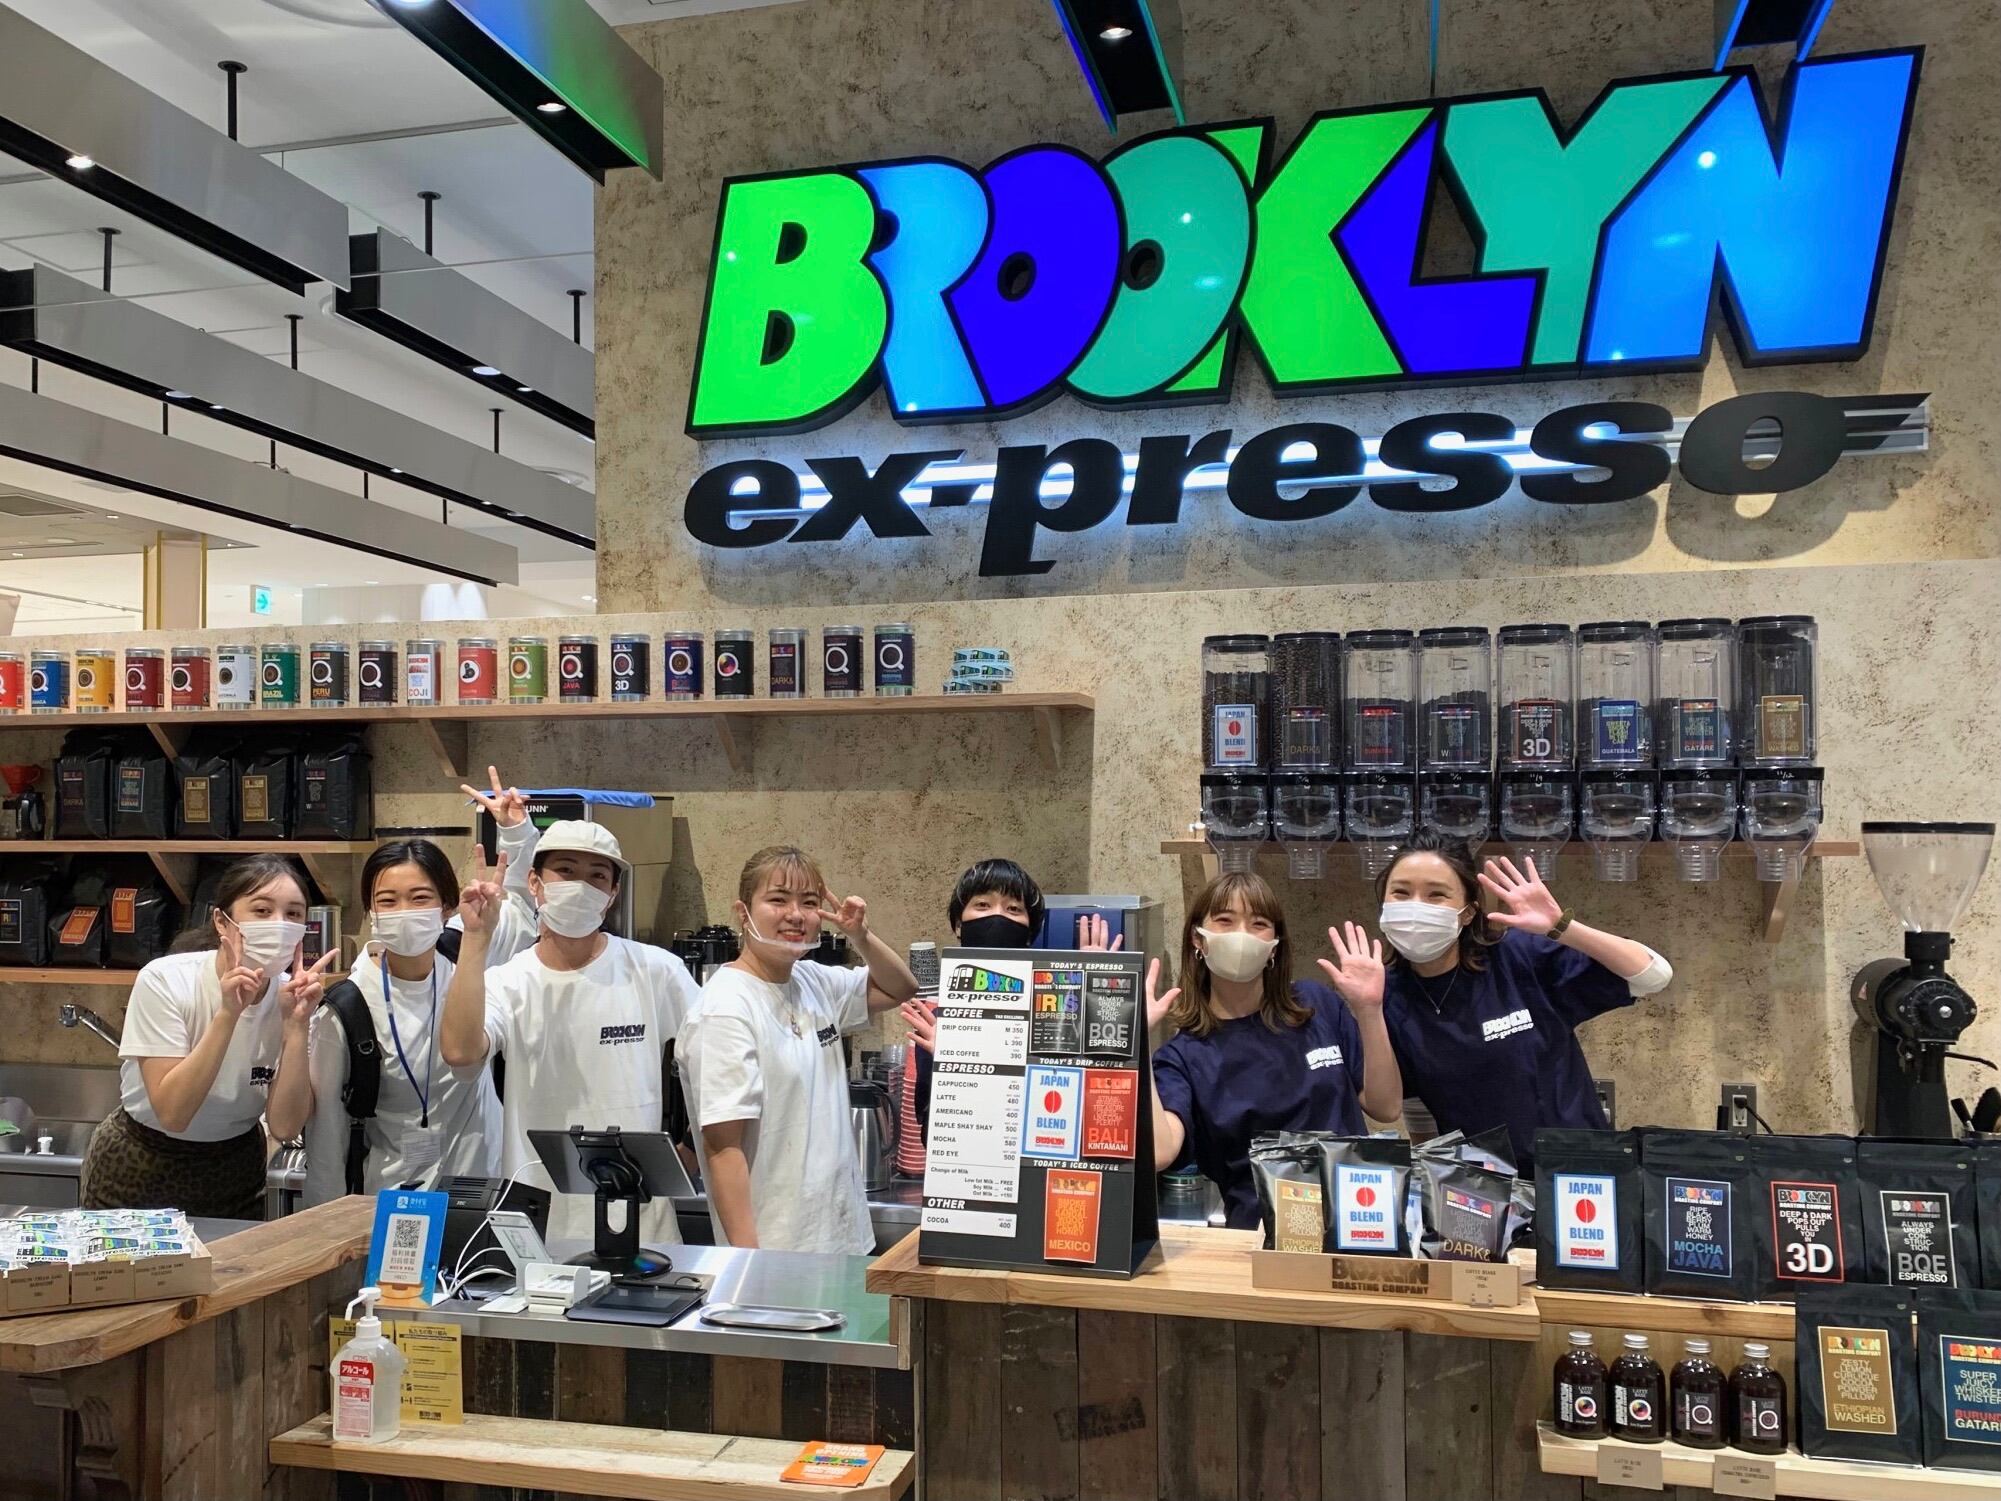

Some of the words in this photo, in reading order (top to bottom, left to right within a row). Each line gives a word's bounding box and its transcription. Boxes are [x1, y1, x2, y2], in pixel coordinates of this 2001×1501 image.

[686, 47, 1923, 438] BROOKLYN
[684, 391, 1932, 577] ex-presso
[615, 681, 629, 690] 3D
[313, 688, 330, 697] PERU
[1226, 711, 1245, 719] JAPAN
[1225, 738, 1245, 746] BLEND
[1523, 738, 1551, 757] 3D
[947, 992, 1023, 1002] ex-presso
[1036, 994, 1079, 1012] IRIS
[942, 1008, 983, 1018] COFFEE
[1036, 1012, 1078, 1020] ESPRESSO
[1089, 1022, 1128, 1040] BQE
[1484, 1022, 1534, 1042] ex-presso
[1088, 1039, 1128, 1048] ESPRESSO
[938, 1063, 994, 1074] ESPRESSO
[1095, 1060, 1124, 1068] COFFEE
[938, 1080, 978, 1088] CAPPUCCINO
[1040, 1075, 1070, 1087] JAPAN
[936, 1108, 974, 1116] AMERICANO
[957, 1122, 974, 1130] SHAY
[1036, 1117, 1066, 1130] BLEND
[1088, 1128, 1129, 1144] BALI
[1088, 1142, 1128, 1152] KINTAMANI
[1070, 1161, 1088, 1169] ICED
[1090, 1162, 1118, 1171] COFFEE
[1350, 1172, 1382, 1184] JAPAN
[1568, 1182, 1602, 1195] JAPAN
[928, 1198, 966, 1209] OTHER
[926, 1216, 948, 1224] COCOA
[1350, 1211, 1384, 1222] BLEND
[1780, 1210, 1800, 1218] DEEP
[1810, 1212, 1832, 1220] DARK
[1788, 1218, 1809, 1226] POPS
[1902, 1220, 1934, 1228] ALWAYS
[1796, 1224, 1820, 1232] PULLS
[1903, 1226, 1932, 1234] UNDER
[1570, 1228, 1604, 1240] BLEND
[1686, 1232, 1714, 1240] HONEY
[1800, 1230, 1816, 1238] YOU
[1908, 1232, 1928, 1240] CON-
[1049, 1240, 1090, 1252] MEXICO
[1904, 1238, 1934, 1246] STRUC-
[1282, 1244, 1322, 1252] WASHE
[1674, 1240, 1724, 1256] MOCHA
[1910, 1244, 1930, 1252] TION
[1674, 1251, 1724, 1270] JAVA
[1786, 1242, 1834, 1273] 3D
[1898, 1252, 1948, 1274] BQE
[1898, 1272, 1948, 1283] ESPRESSO
[1332, 1280, 1379, 1292] ROASTING
[1382, 1284, 1429, 1294] COMPANY
[1840, 1358, 1870, 1367] ZESTY
[341, 1364, 369, 1375] アルコール
[1840, 1364, 1872, 1373] LEMON
[1960, 1369, 1997, 1381] SUPER
[1964, 1378, 1994, 1389] JUICY
[1838, 1384, 1878, 1394] POWDER
[1842, 1392, 1876, 1400] PILLOW
[1834, 1404, 1885, 1414] ETHIOPIAN
[1835, 1412, 1886, 1424] WASHED
